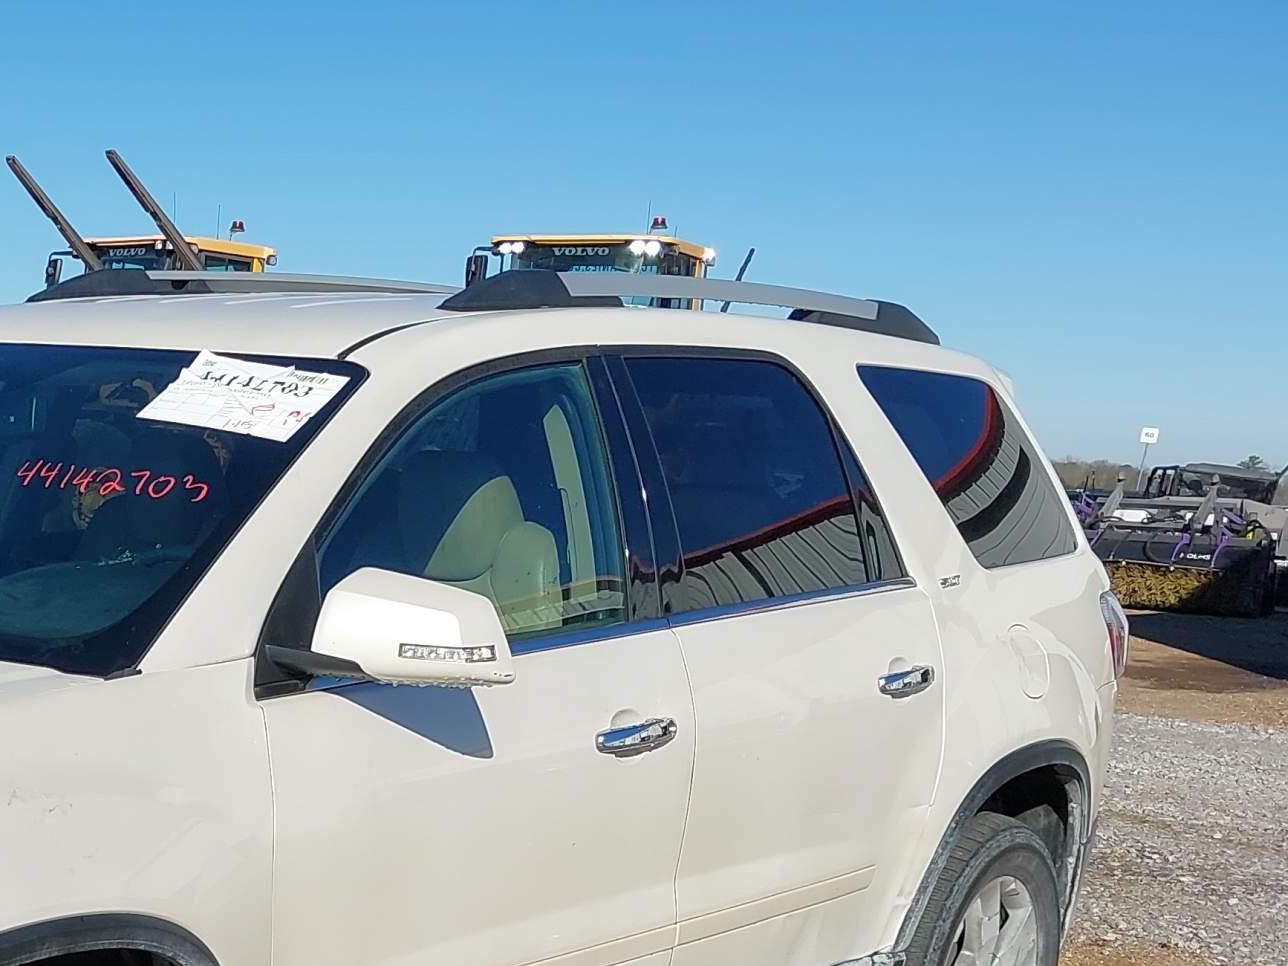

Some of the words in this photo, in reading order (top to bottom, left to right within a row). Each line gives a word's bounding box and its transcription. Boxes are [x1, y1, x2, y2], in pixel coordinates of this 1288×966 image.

[109, 248, 146, 256] VOLVO
[552, 247, 609, 256] VOLVO
[16, 459, 210, 502] 44142703
